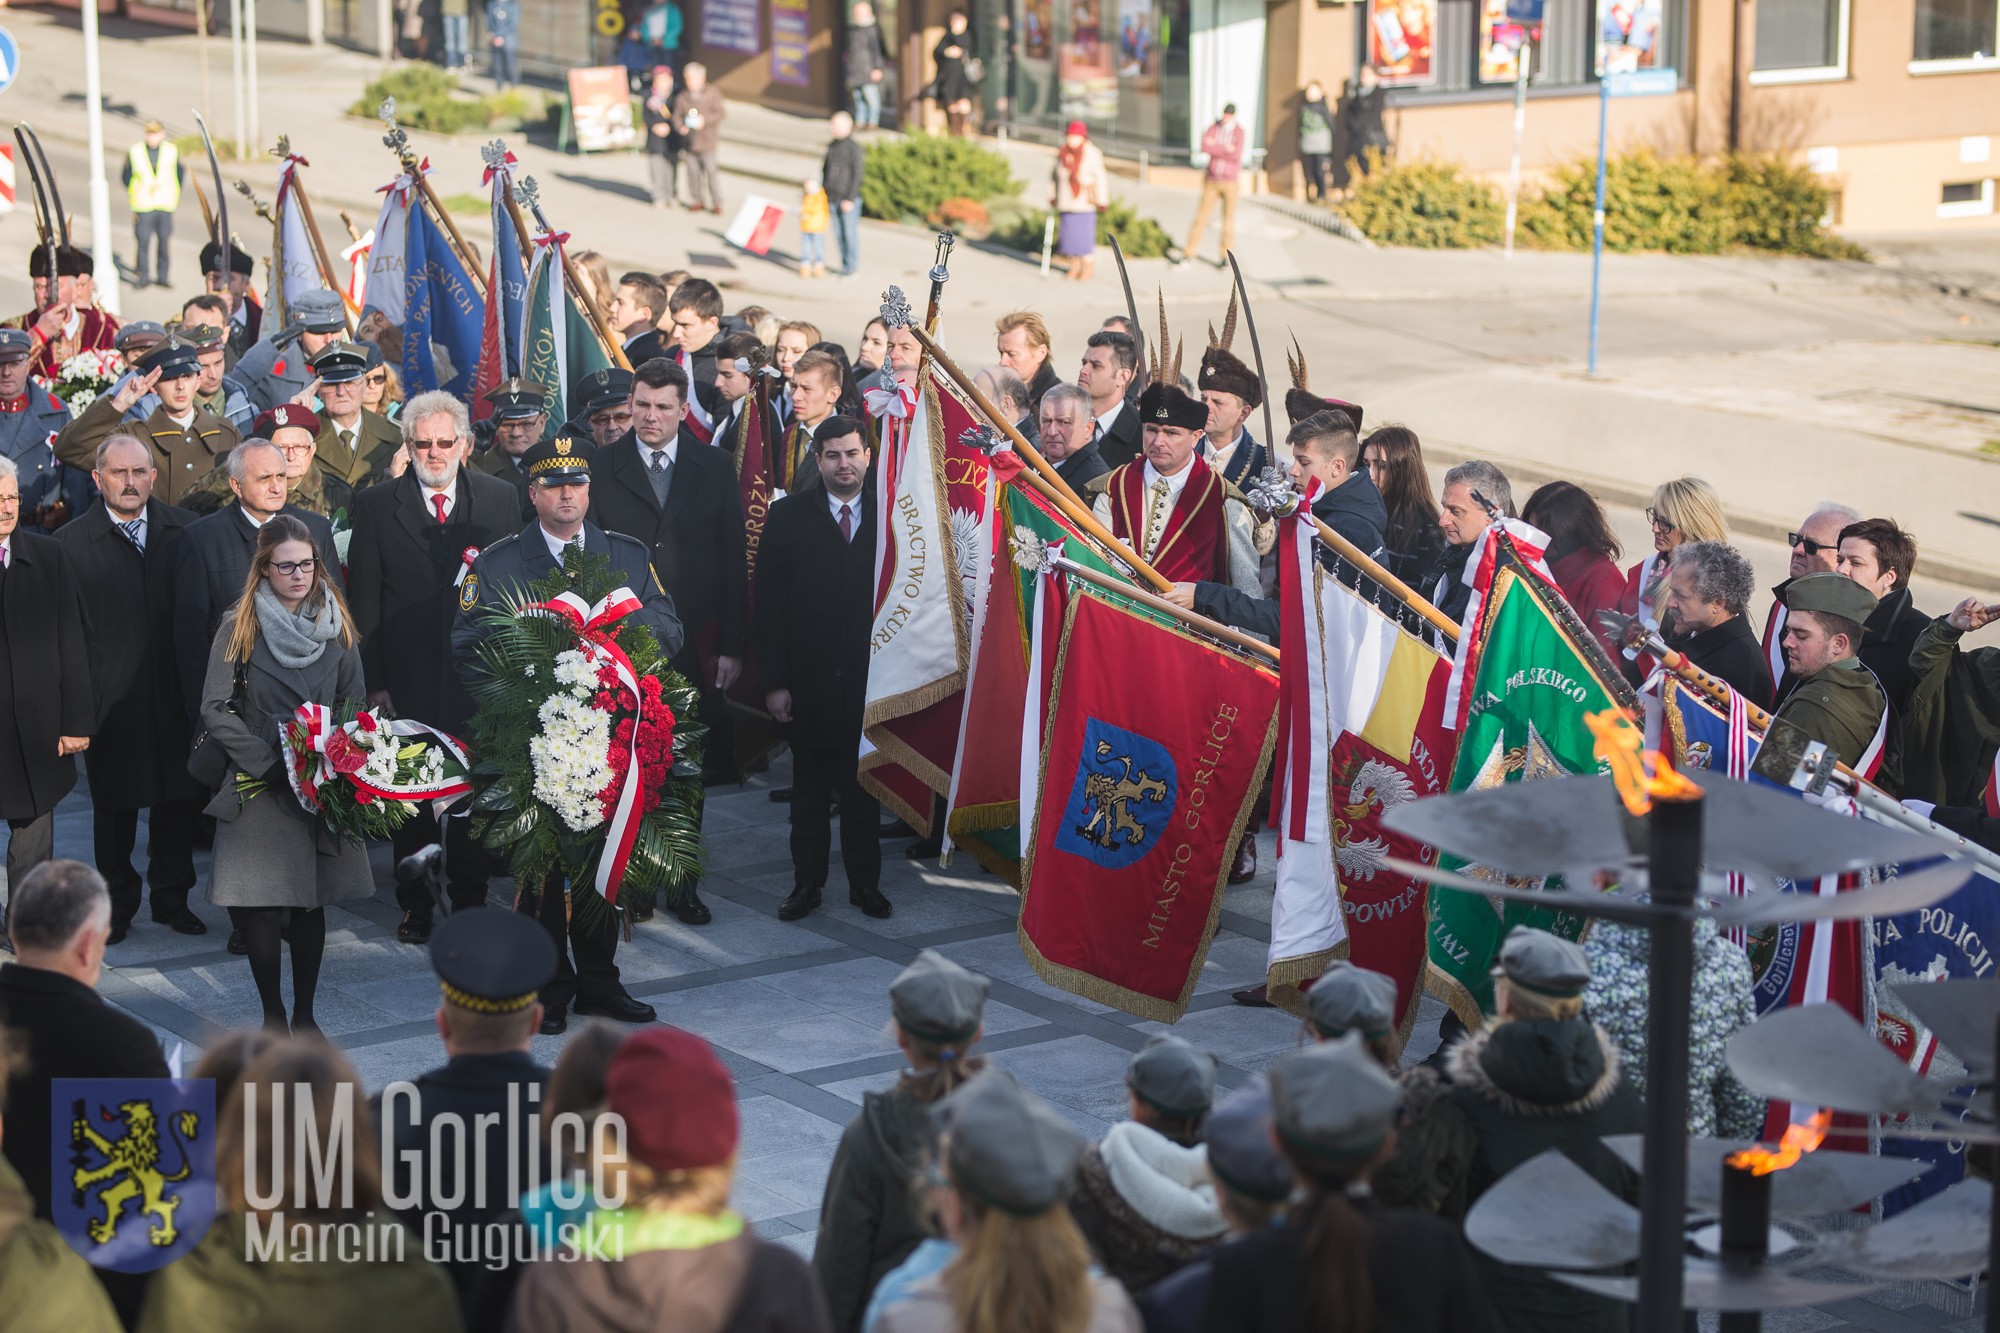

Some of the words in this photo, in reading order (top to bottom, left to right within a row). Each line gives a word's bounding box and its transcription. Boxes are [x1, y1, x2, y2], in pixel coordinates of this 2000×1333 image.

[897, 493, 926, 599] BRACTWO
[870, 604, 912, 654] KURK
[1506, 668, 1587, 703] POLSKIEGO
[1142, 843, 1192, 949] MIASTO
[1185, 703, 1239, 831] GORLICE
[1917, 907, 1994, 978] POLICJI
